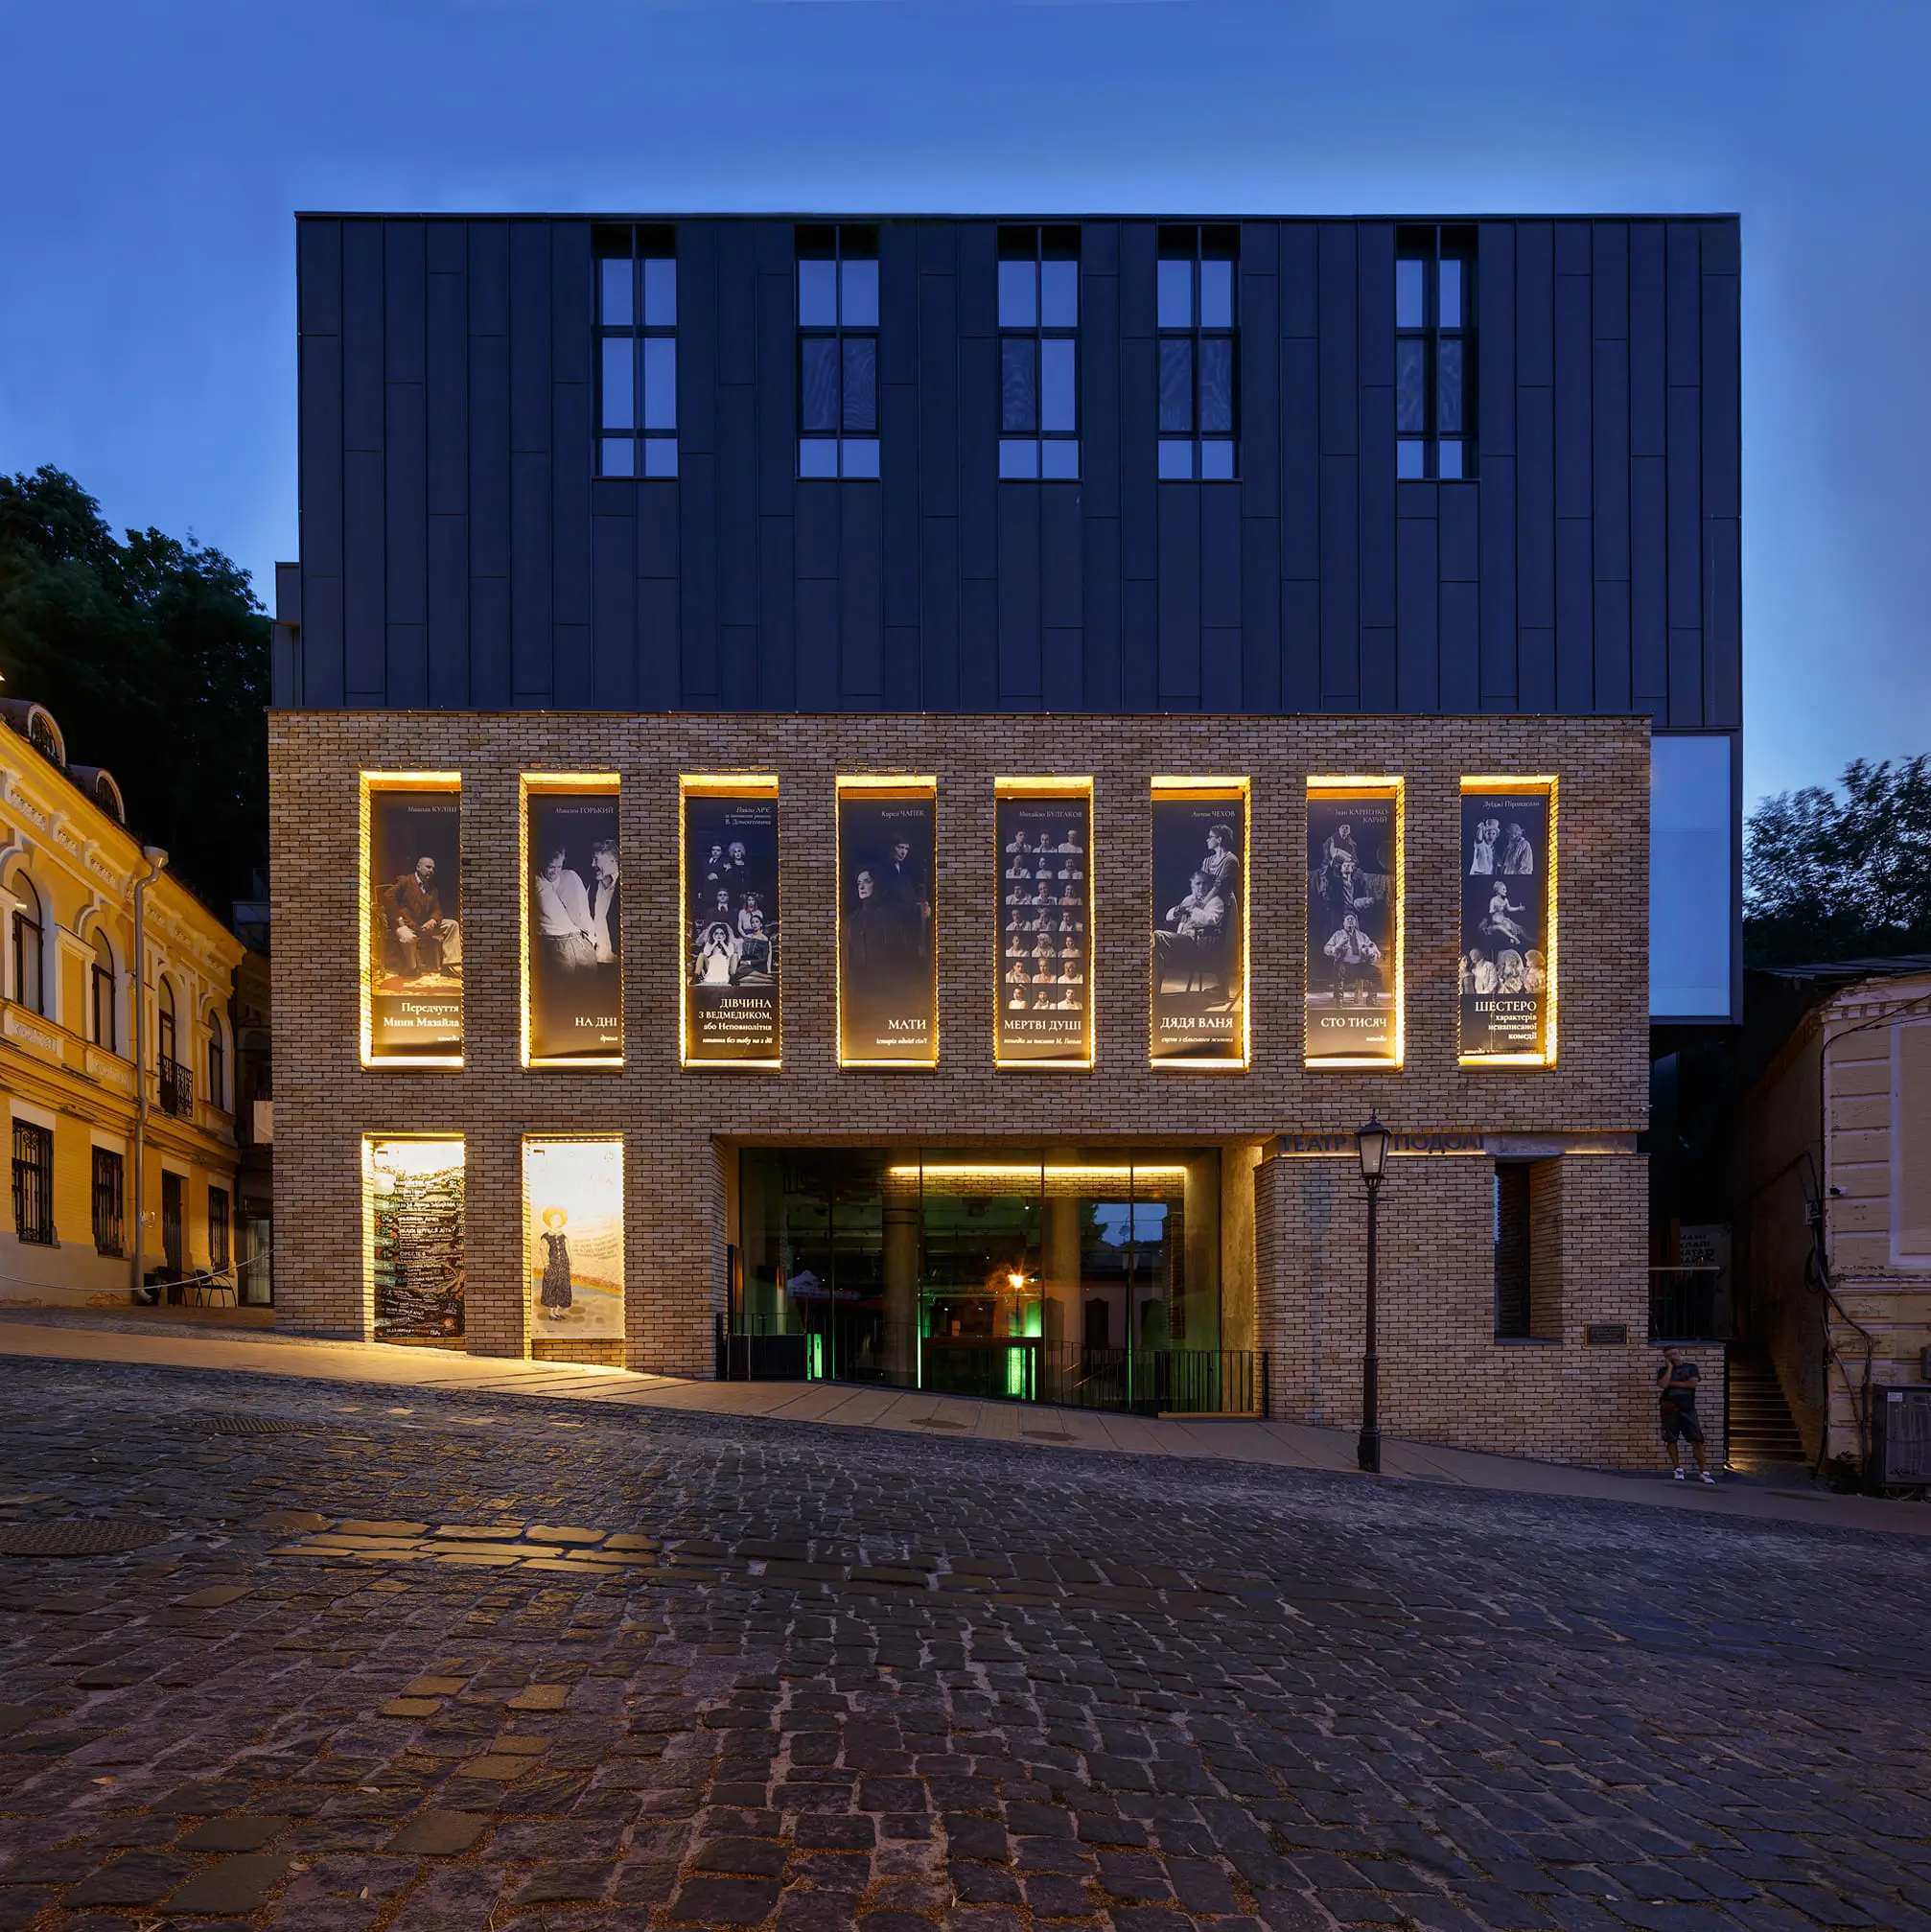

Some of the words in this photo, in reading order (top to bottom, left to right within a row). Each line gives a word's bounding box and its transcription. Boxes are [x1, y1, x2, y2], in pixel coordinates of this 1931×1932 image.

[401, 1002, 459, 1015] Передчуття
[719, 998, 773, 1010] ДІВЧИНА
[1475, 1000, 1538, 1012] ШЕСТЕРО
[698, 1011, 705, 1019] З
[706, 1011, 773, 1020] ВЕДМЕДИКОМ,
[1495, 1013, 1538, 1023] характерів
[384, 1016, 414, 1027] Мини
[416, 1016, 459, 1027] Мазайла
[574, 1016, 593, 1027] НА
[594, 1016, 617, 1028] ДНІ
[703, 1022, 717, 1031] або
[718, 1022, 773, 1031] Неповнолітня
[888, 1019, 927, 1030] МАТИ
[1004, 1019, 1047, 1030] МЕРТВІ
[1048, 1020, 1082, 1032] ДУШІ
[1159, 1017, 1196, 1030] ДЯДЯ
[1198, 1017, 1234, 1029] ВАНЯ
[1320, 1017, 1346, 1028] СТО
[1347, 1017, 1387, 1028] ТИСЯЧ
[1488, 1022, 1538, 1031] ненаписаної
[1281, 1135, 1347, 1152] ТЕАТР
[1394, 1134, 1484, 1154] ПОДОЛІ
